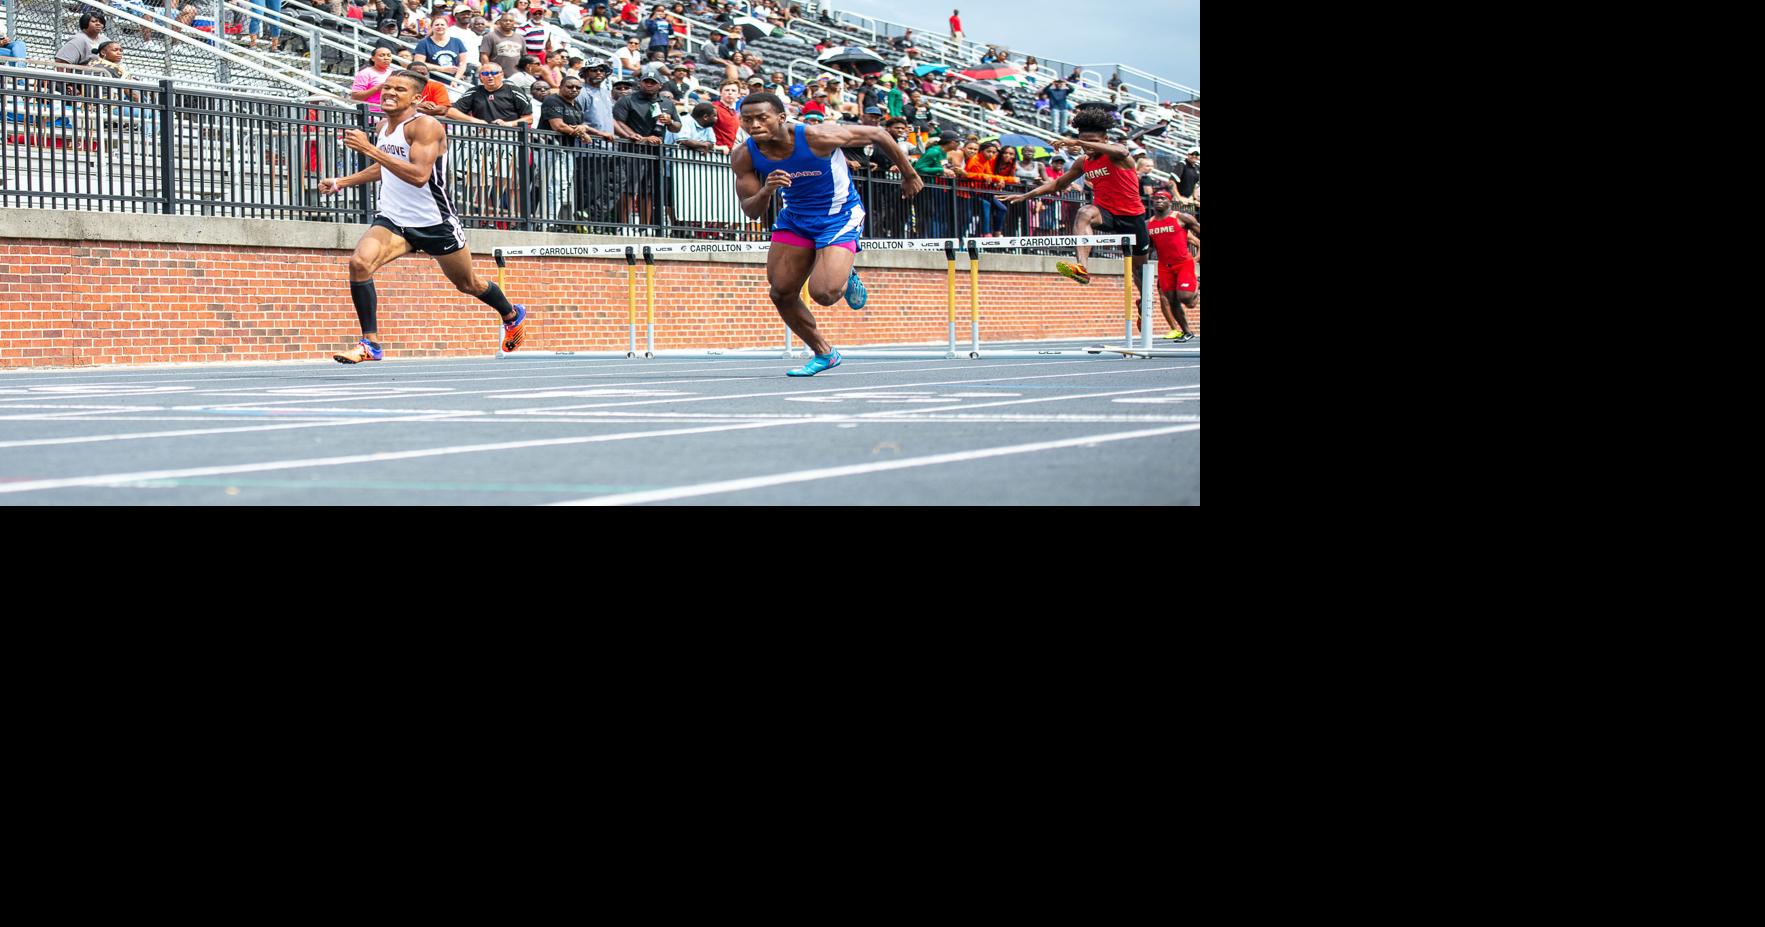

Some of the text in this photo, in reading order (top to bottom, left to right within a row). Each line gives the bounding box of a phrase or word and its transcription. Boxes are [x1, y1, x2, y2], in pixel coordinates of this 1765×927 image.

[1149, 225, 1175, 235] ROME
[861, 241, 903, 249] RROLLTON
[1020, 238, 1077, 246] CARROLLTON
[540, 247, 588, 255] CARROLLTON
[690, 244, 741, 252] CARROLLTON
